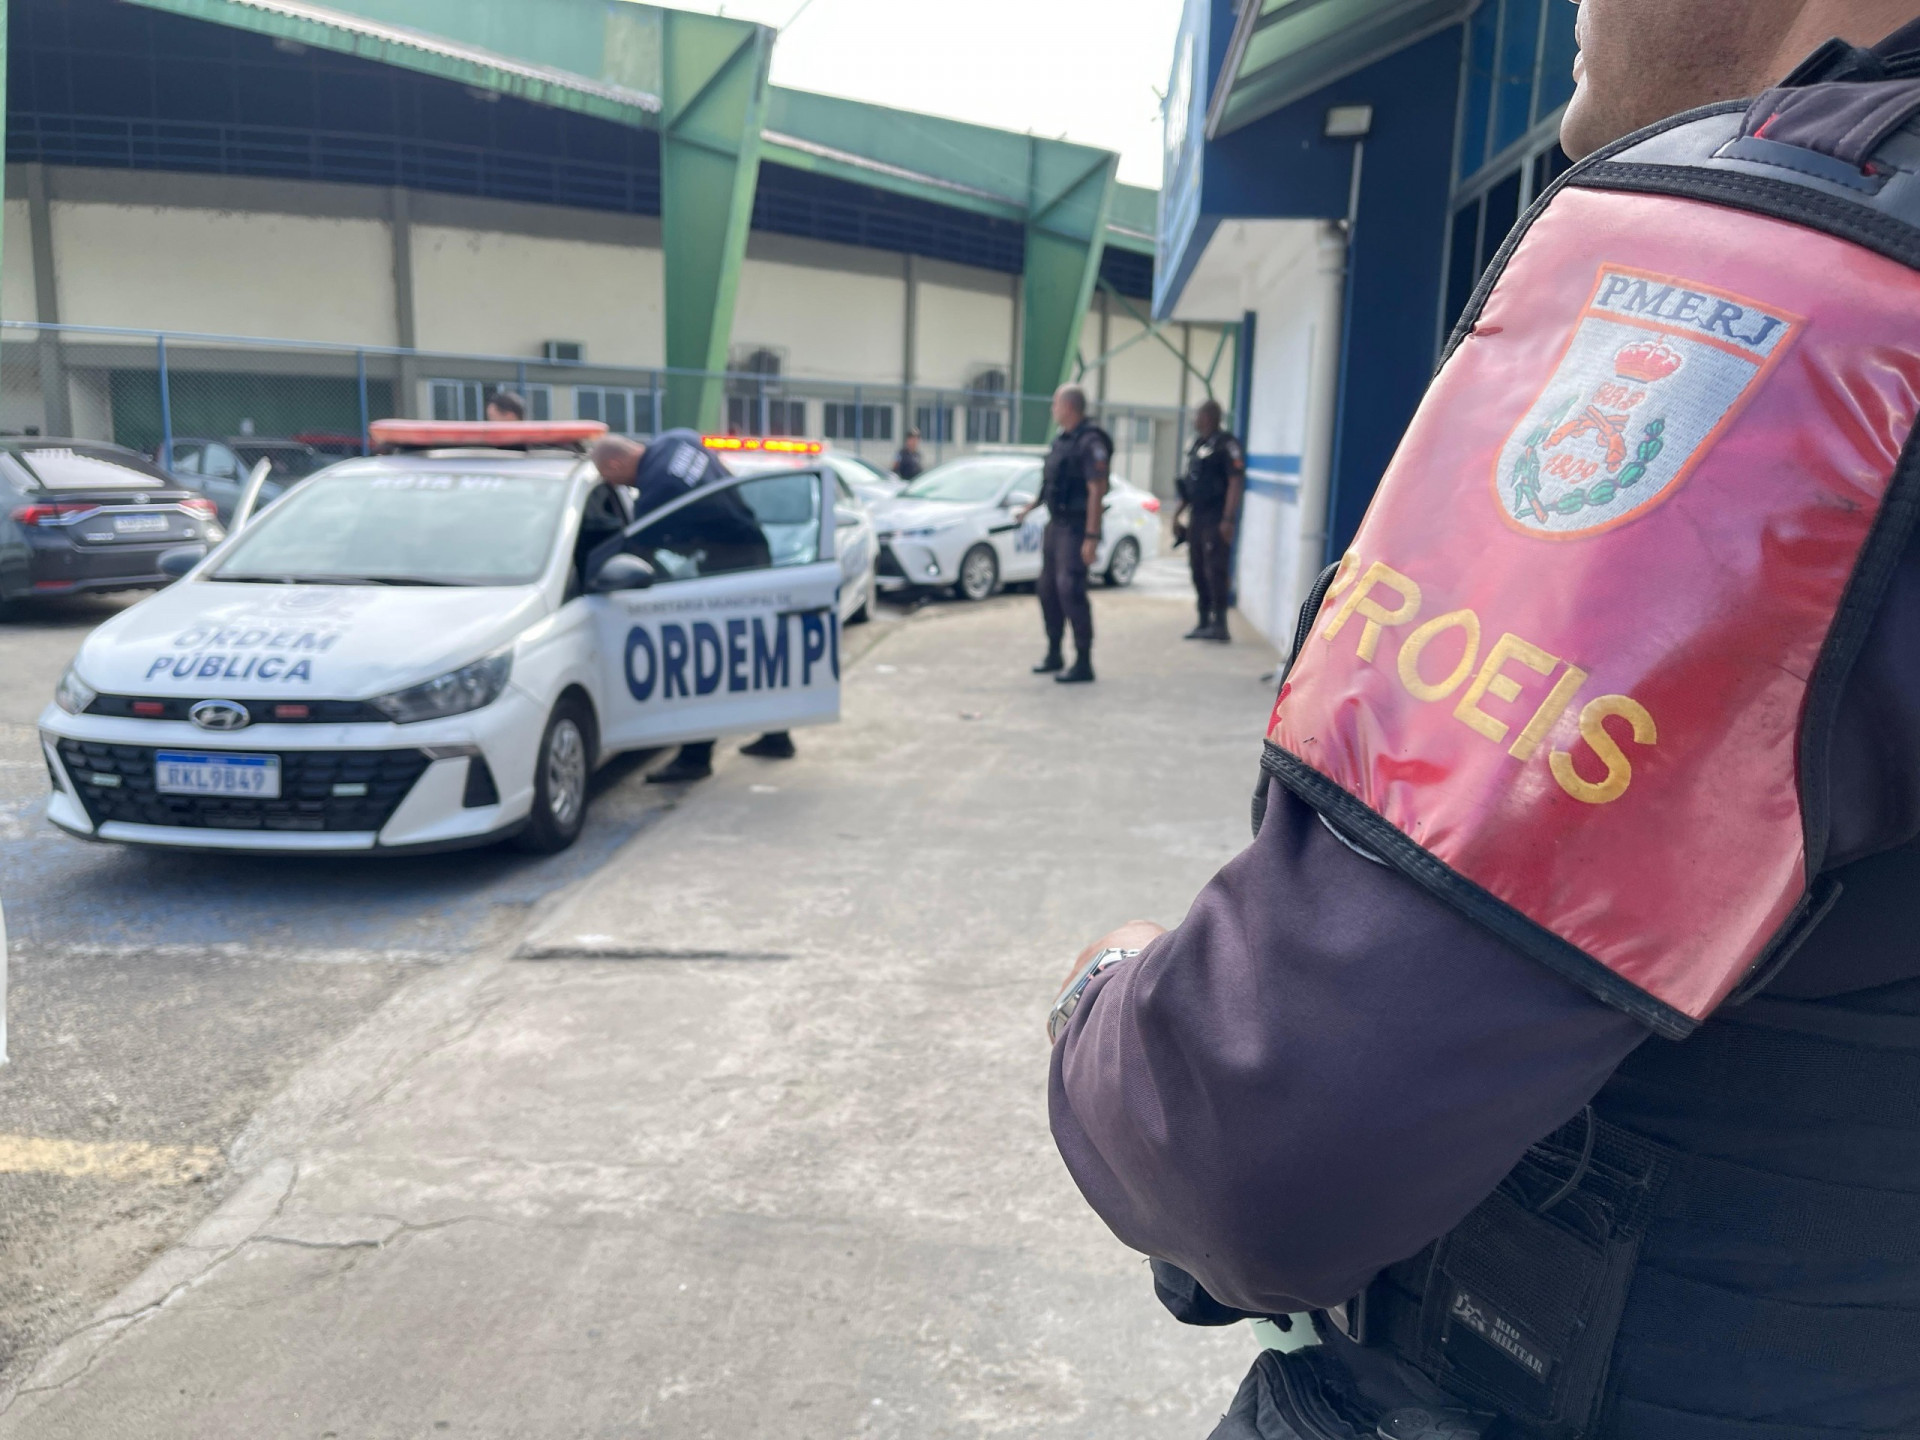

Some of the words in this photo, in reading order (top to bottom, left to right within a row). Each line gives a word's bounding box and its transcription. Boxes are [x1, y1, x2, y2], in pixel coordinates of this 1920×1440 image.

[1597, 275, 1782, 345] PMERJ
[174, 627, 341, 650] ORDEM
[625, 614, 788, 702] ORDEM
[1323, 551, 1657, 804] PROEIS
